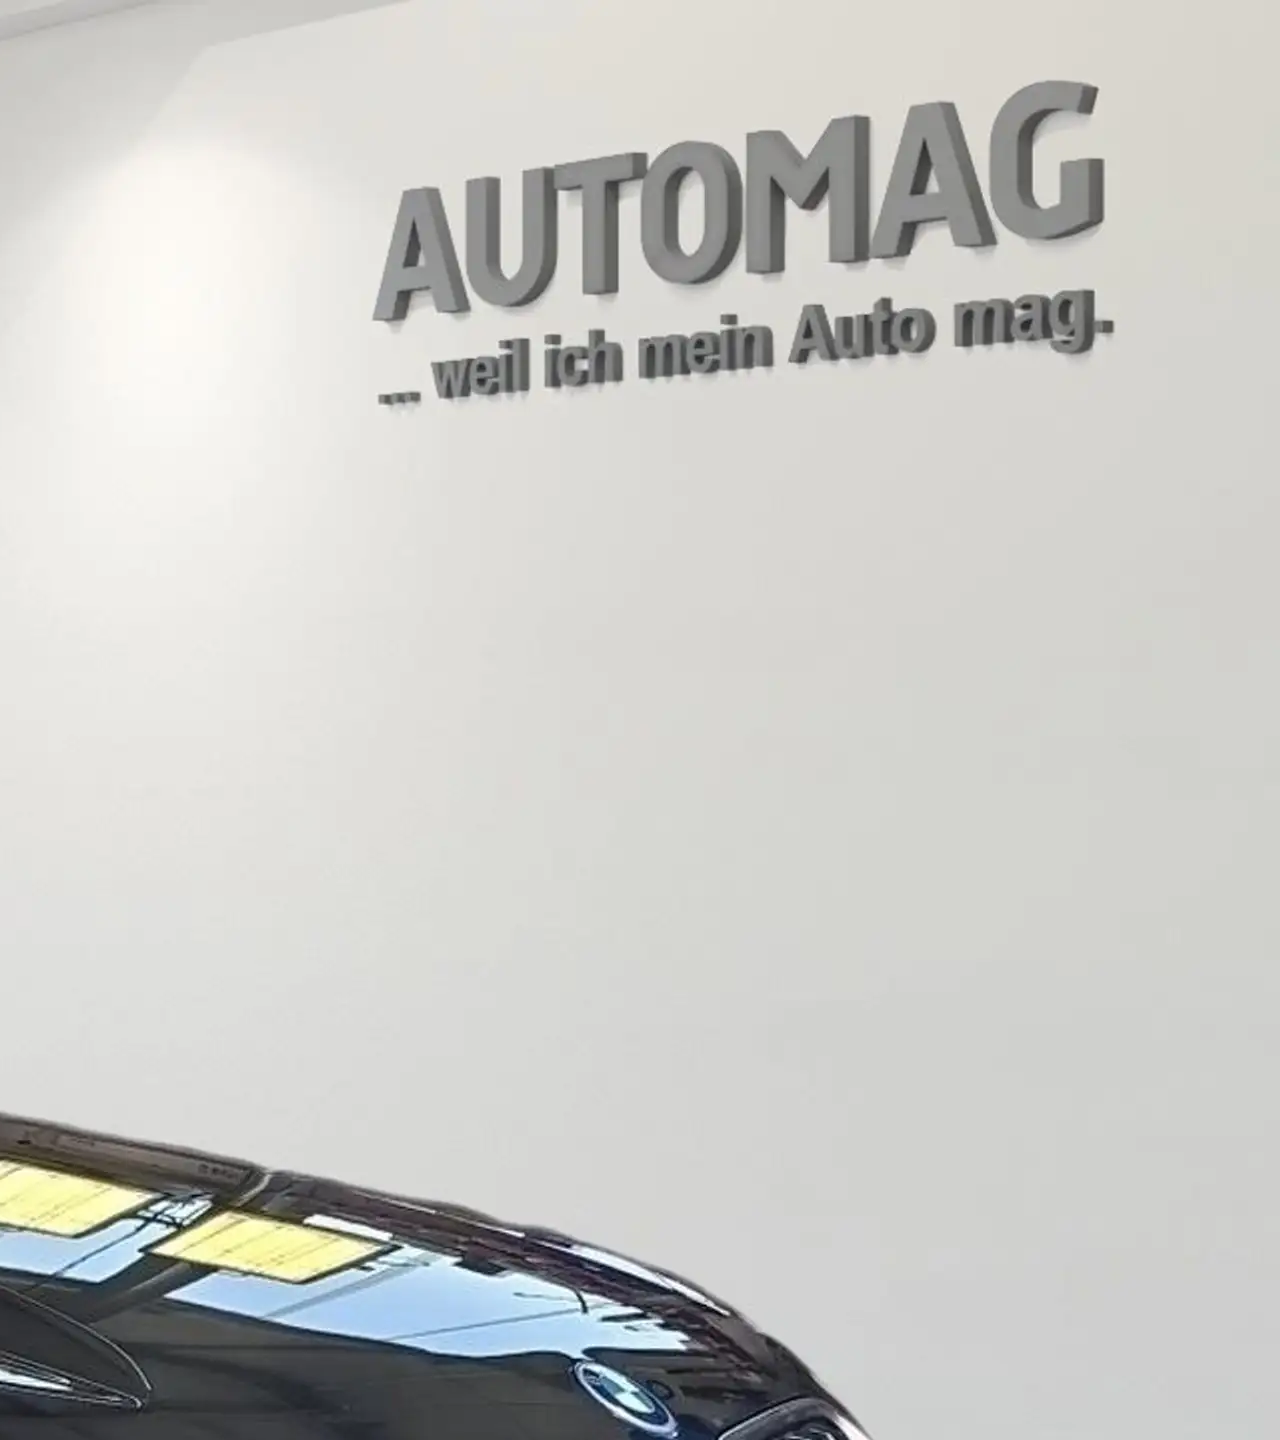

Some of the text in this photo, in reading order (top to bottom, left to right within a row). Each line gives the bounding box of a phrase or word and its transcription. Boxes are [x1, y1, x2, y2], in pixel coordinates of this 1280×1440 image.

[372, 79, 1105, 321] AUTOMAG
[431, 337, 530, 399] weil
[543, 328, 623, 390] ich
[638, 313, 774, 379] mein
[787, 296, 936, 363] Auto
[953, 287, 1115, 354] mag.
